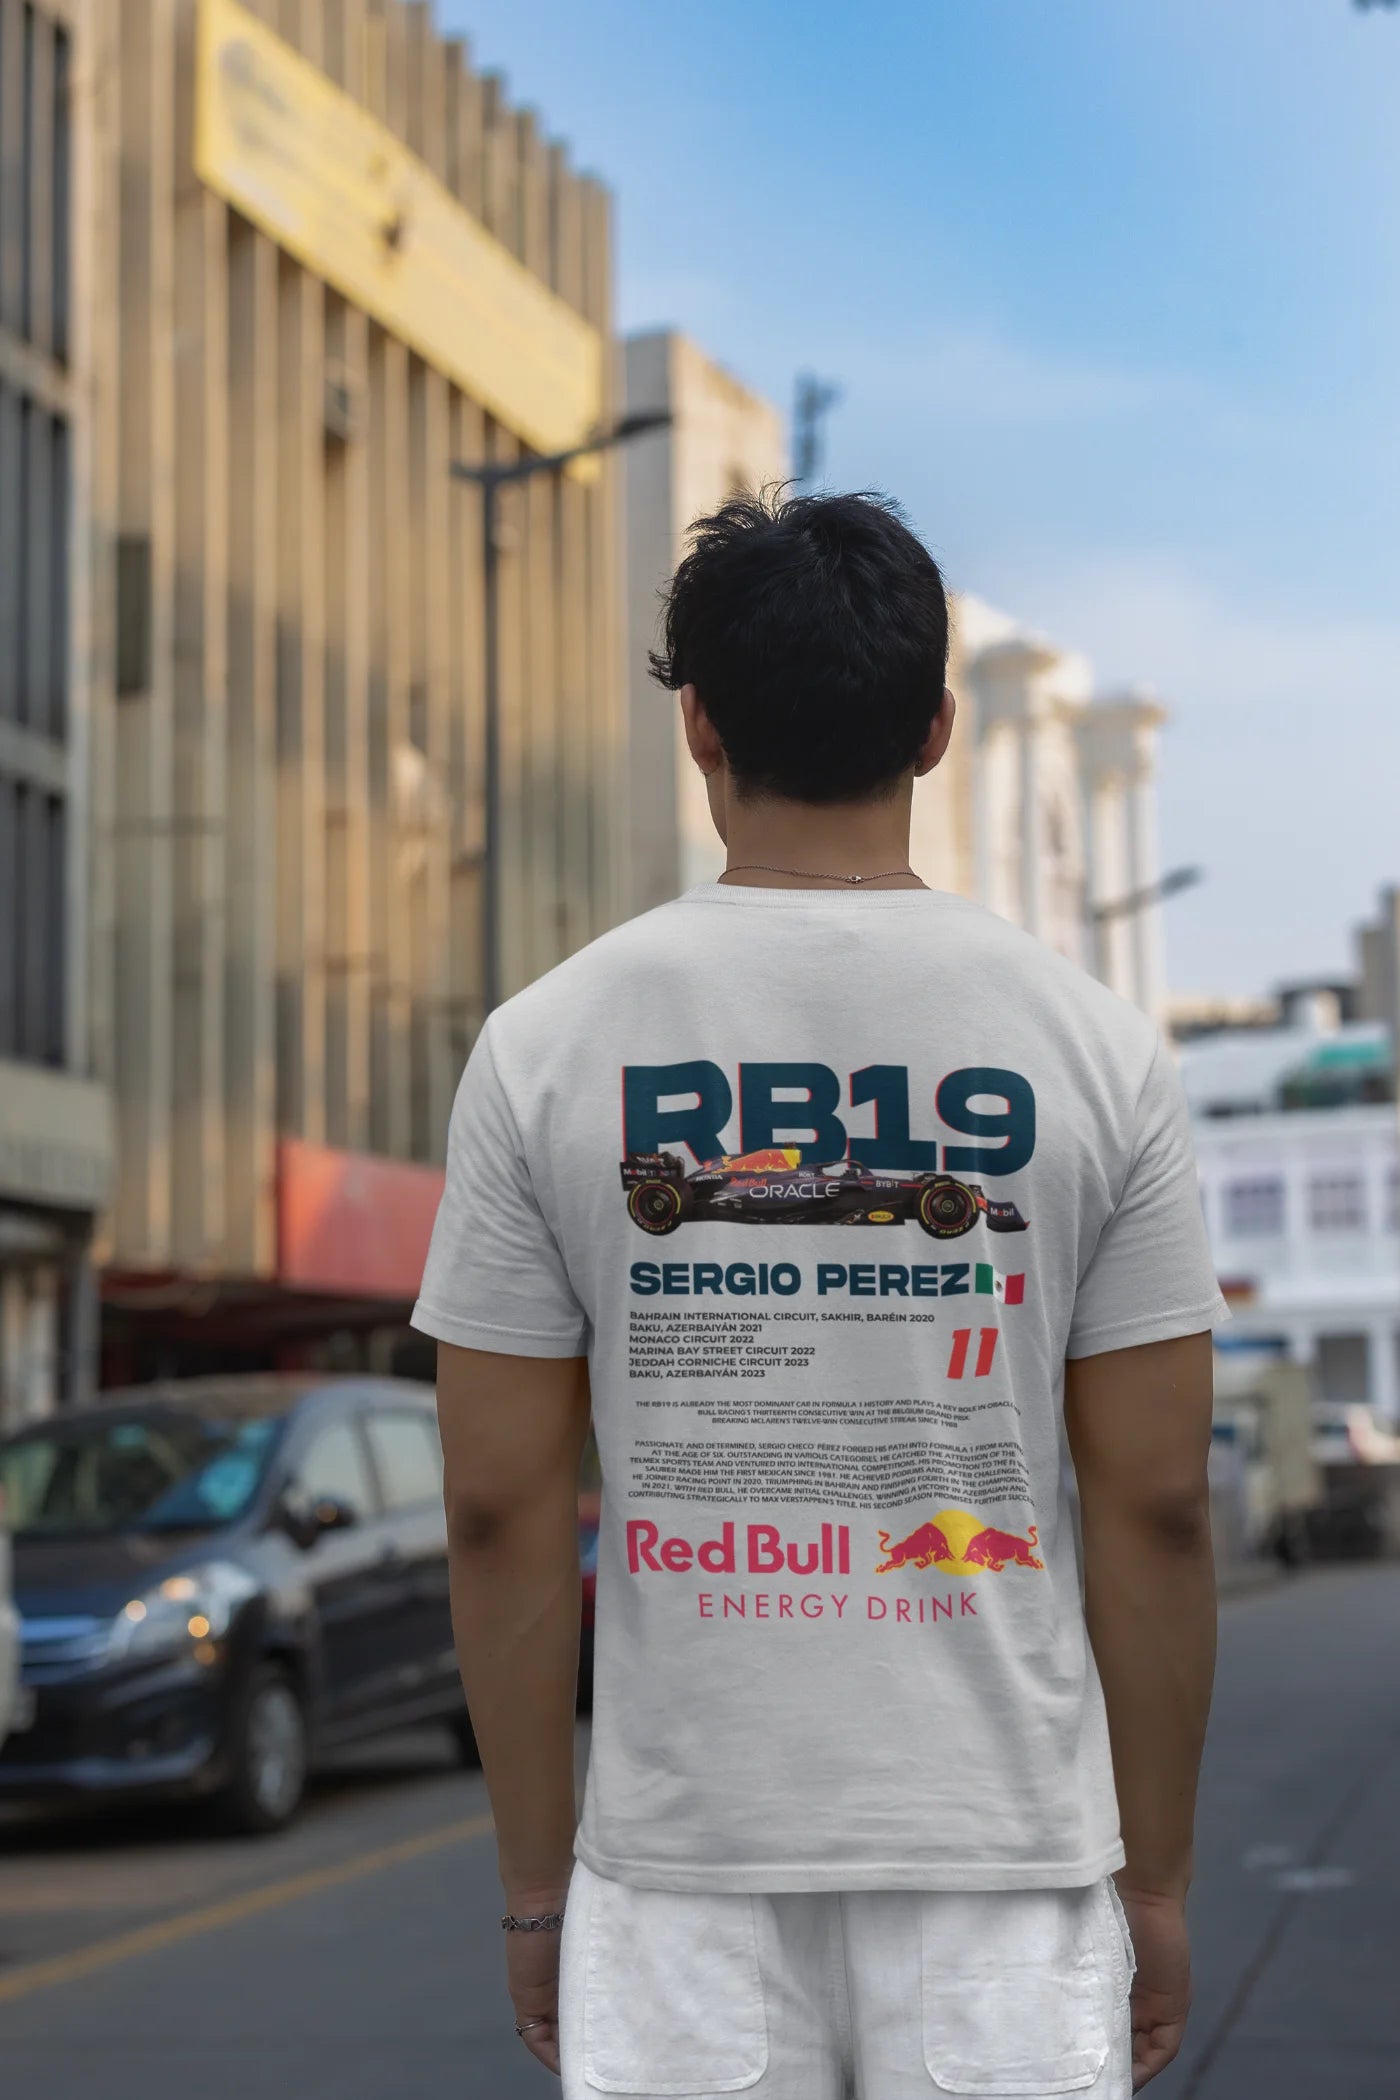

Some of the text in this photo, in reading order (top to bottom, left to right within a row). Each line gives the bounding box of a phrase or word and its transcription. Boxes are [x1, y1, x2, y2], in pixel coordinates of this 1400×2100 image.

[622, 1060, 1036, 1177] RB19
[750, 1182, 840, 1198] ORACLE
[990, 1208, 1014, 1216] Mobil
[630, 1262, 970, 1296] SERGIO PEREZ
[630, 1312, 680, 1320] BAHRAIN
[684, 1312, 770, 1320] INTERNATIONAL
[774, 1313, 818, 1322] CIRCUIT,
[821, 1313, 864, 1322] SAKHIR,
[867, 1312, 906, 1322] BARÉIN
[630, 1323, 663, 1333] BAKU,
[666, 1322, 736, 1332] AZERBAIYÁN
[630, 1335, 679, 1344] MONACO
[629, 1347, 674, 1355] MARINA
[947, 1328, 998, 1380] 11
[629, 1370, 663, 1379] BAKU,
[666, 1368, 737, 1377] AZERBAIYÁN
[943, 1403, 956, 1411] KEY
[925, 1408, 952, 1420] GRAND
[635, 1440, 684, 1449] PASSIONATE
[929, 1442, 968, 1453] FORMULA
[976, 1443, 996, 1452] FROM
[892, 1451, 926, 1460] CATCHED
[945, 1452, 988, 1462] ATTENTION
[798, 1461, 860, 1471] INTERNATIONAL
[932, 1459, 980, 1470] PROMOTION
[852, 1473, 890, 1481] ACHIEVED
[892, 1468, 924, 1479] PODIUMS
[947, 1470, 972, 1478] AFTER
[825, 1481, 860, 1490] BAHRAIN
[881, 1479, 915, 1489] FINISHING
[876, 1488, 909, 1498] WINNING
[628, 1491, 685, 1500] CONTRIBUTING
[687, 1494, 748, 1502] STRATEGICALLY
[873, 1500, 902, 1509] SECOND
[904, 1492, 932, 1504] SEASON
[934, 1492, 972, 1504] PROMISES
[974, 1494, 1006, 1505] FURTHER
[626, 1520, 850, 1574] Red Bull
[700, 1592, 978, 1622] ENERGY DRINK
